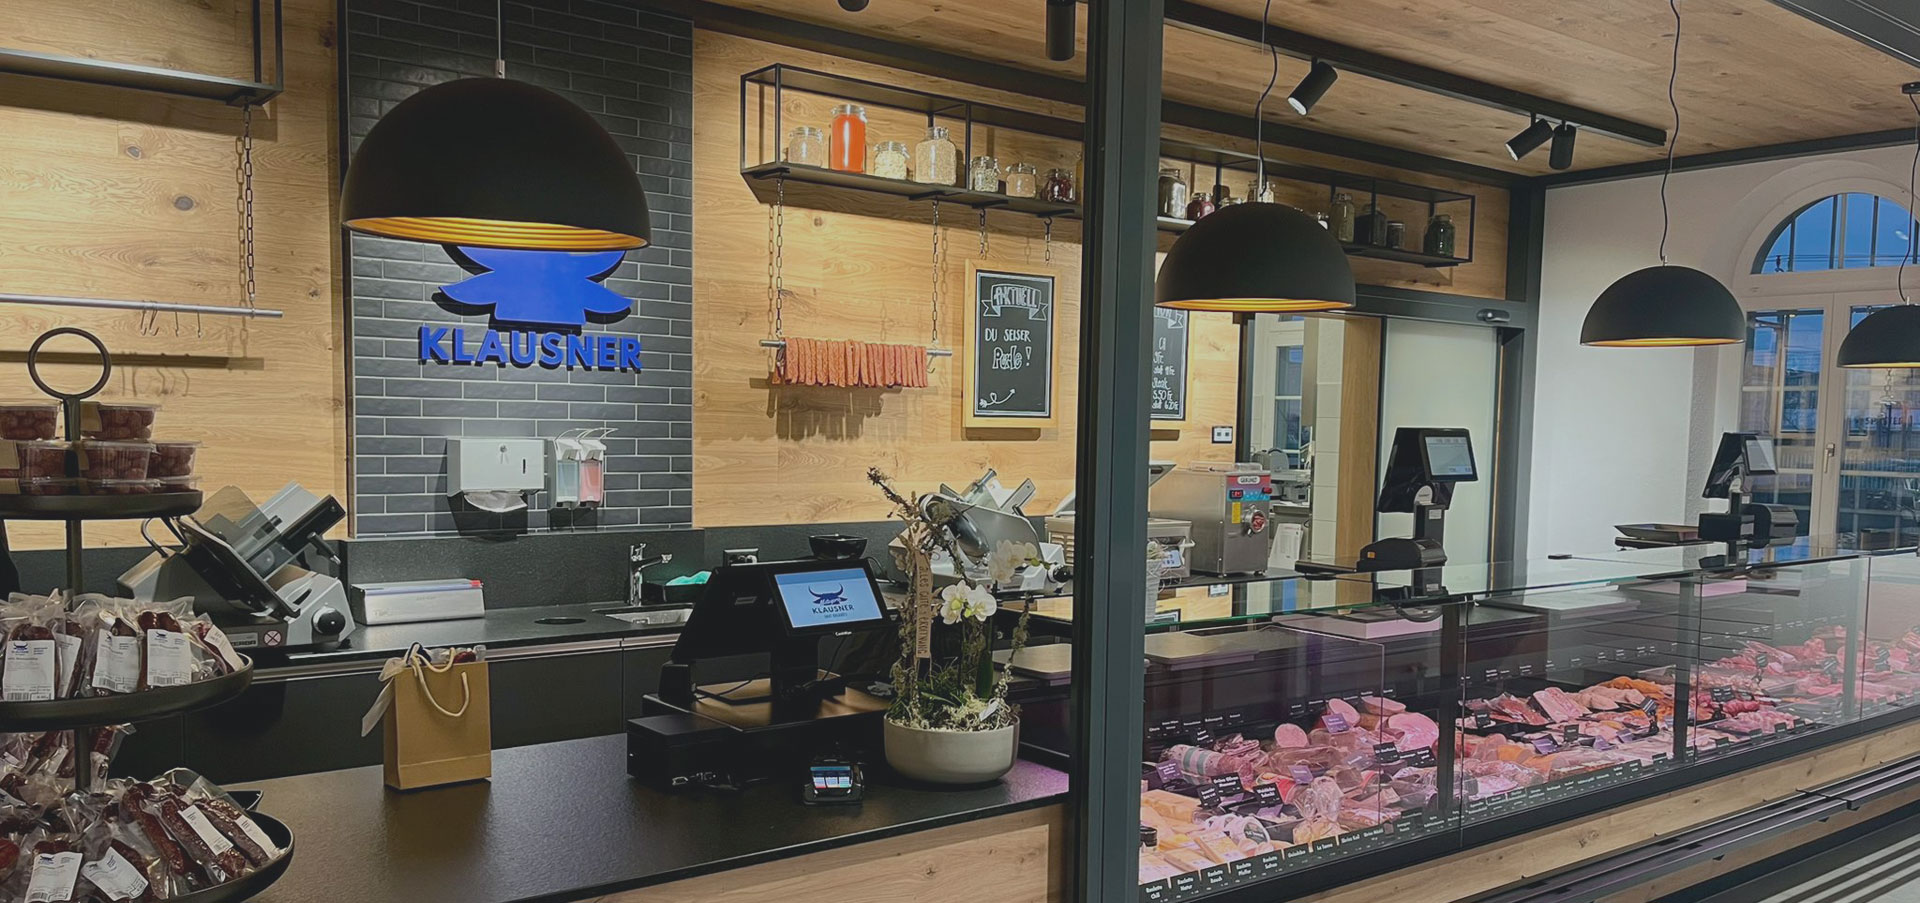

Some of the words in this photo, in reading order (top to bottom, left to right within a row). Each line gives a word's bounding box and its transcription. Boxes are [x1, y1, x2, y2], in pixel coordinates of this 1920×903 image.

[993, 285, 1038, 308] AKTUELL
[984, 328, 998, 342] DU
[1003, 328, 1032, 343] SEISER
[419, 325, 643, 371] KLAUSNER
[811, 604, 854, 614] KLAUSNER
